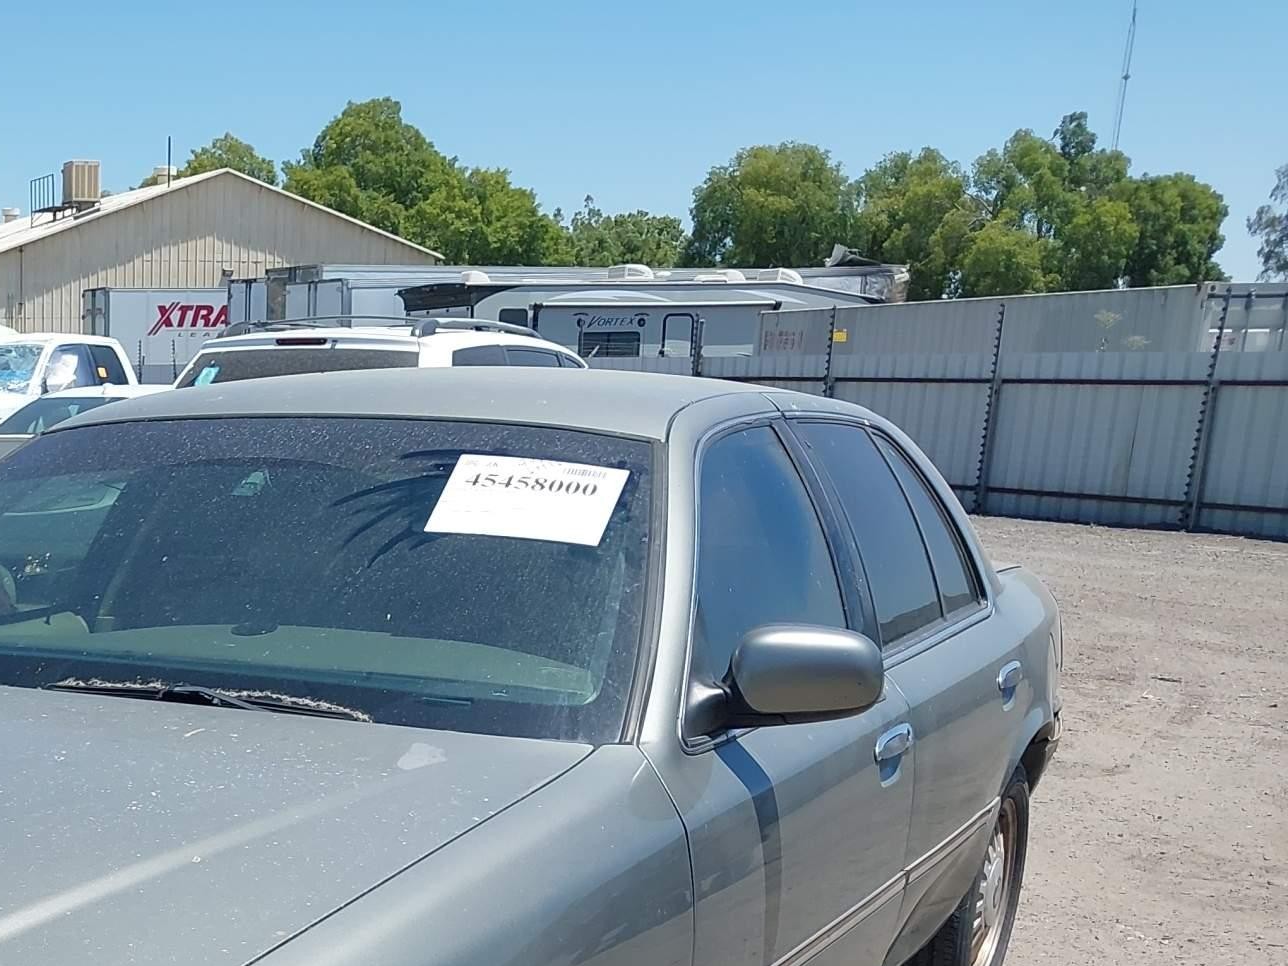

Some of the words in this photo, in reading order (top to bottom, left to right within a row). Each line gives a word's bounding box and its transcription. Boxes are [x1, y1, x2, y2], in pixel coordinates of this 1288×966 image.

[148, 302, 229, 336] XTRA
[587, 316, 636, 328] VORTEX
[465, 472, 598, 497] 45458000
